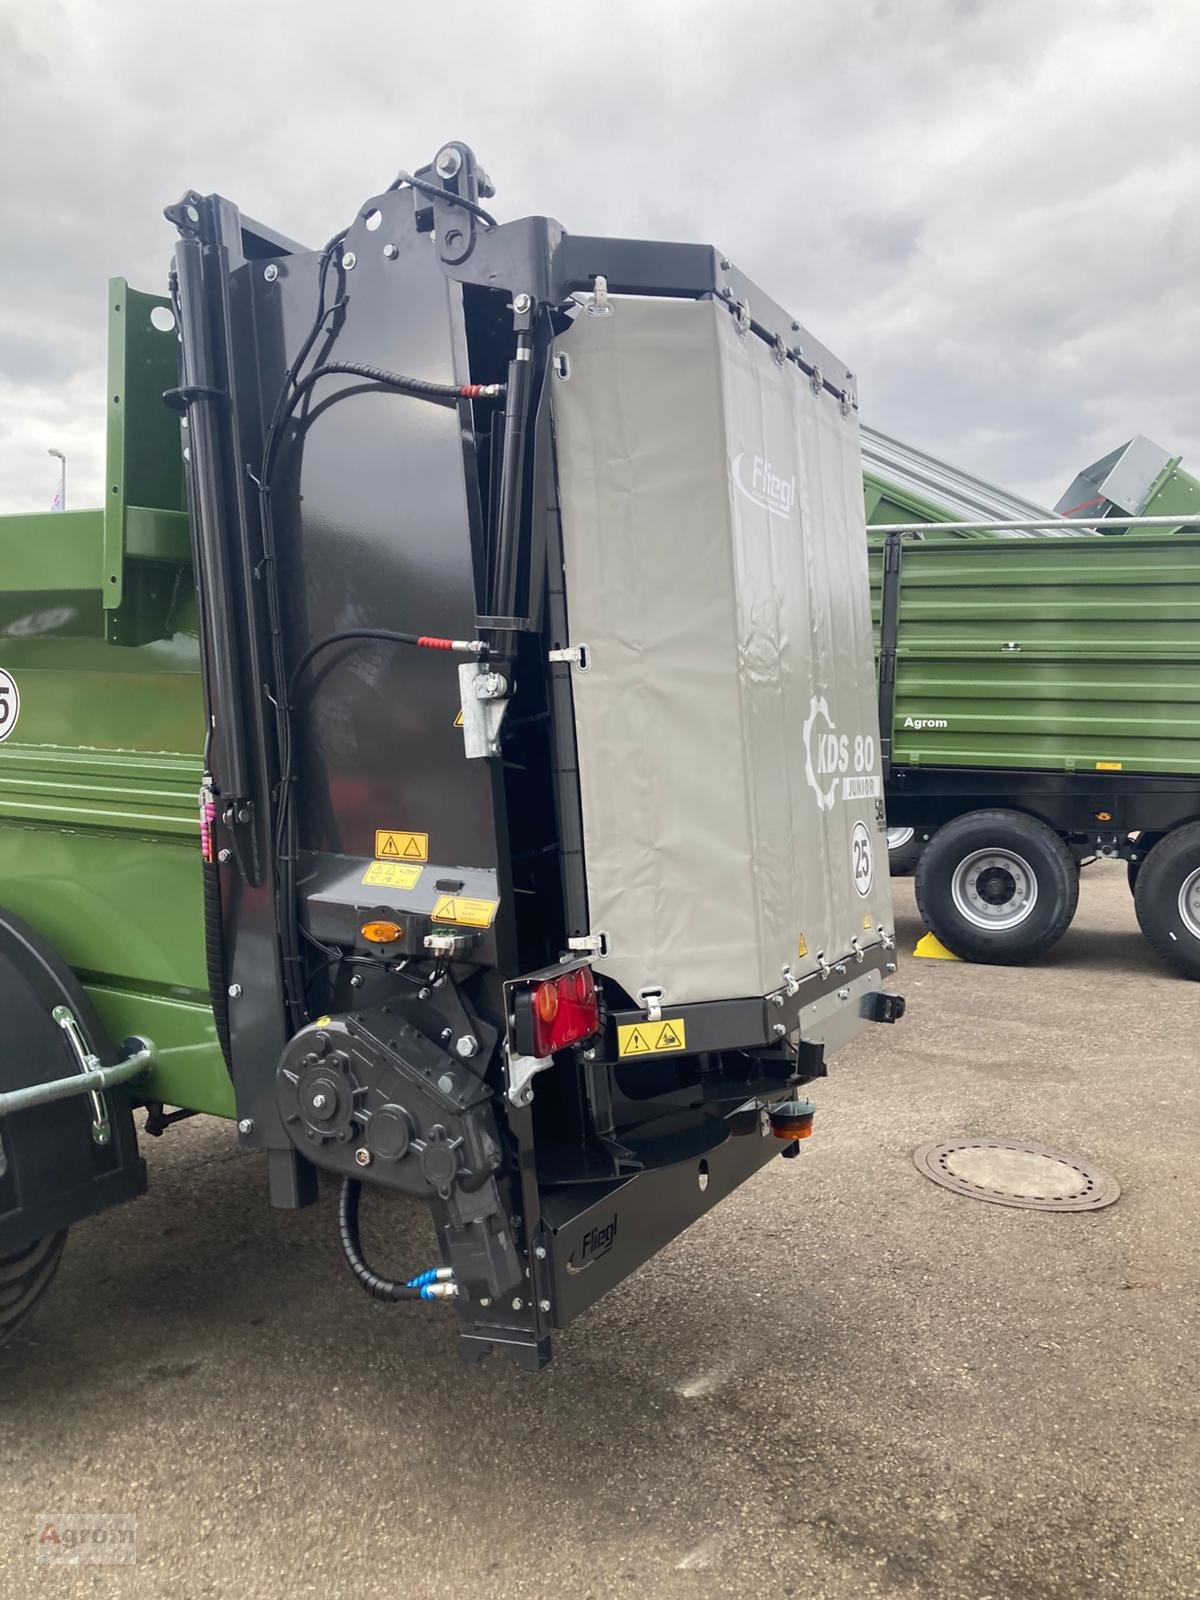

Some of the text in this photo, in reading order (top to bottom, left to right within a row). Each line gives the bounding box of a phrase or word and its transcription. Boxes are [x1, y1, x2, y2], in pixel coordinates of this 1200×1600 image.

[752, 454, 796, 513] Fliegl
[904, 717, 948, 730] Agrom
[817, 733, 874, 774] KDS 80
[848, 778, 875, 797] JUNIOR
[853, 839, 869, 879] 25
[582, 1212, 618, 1259] Fliegl
